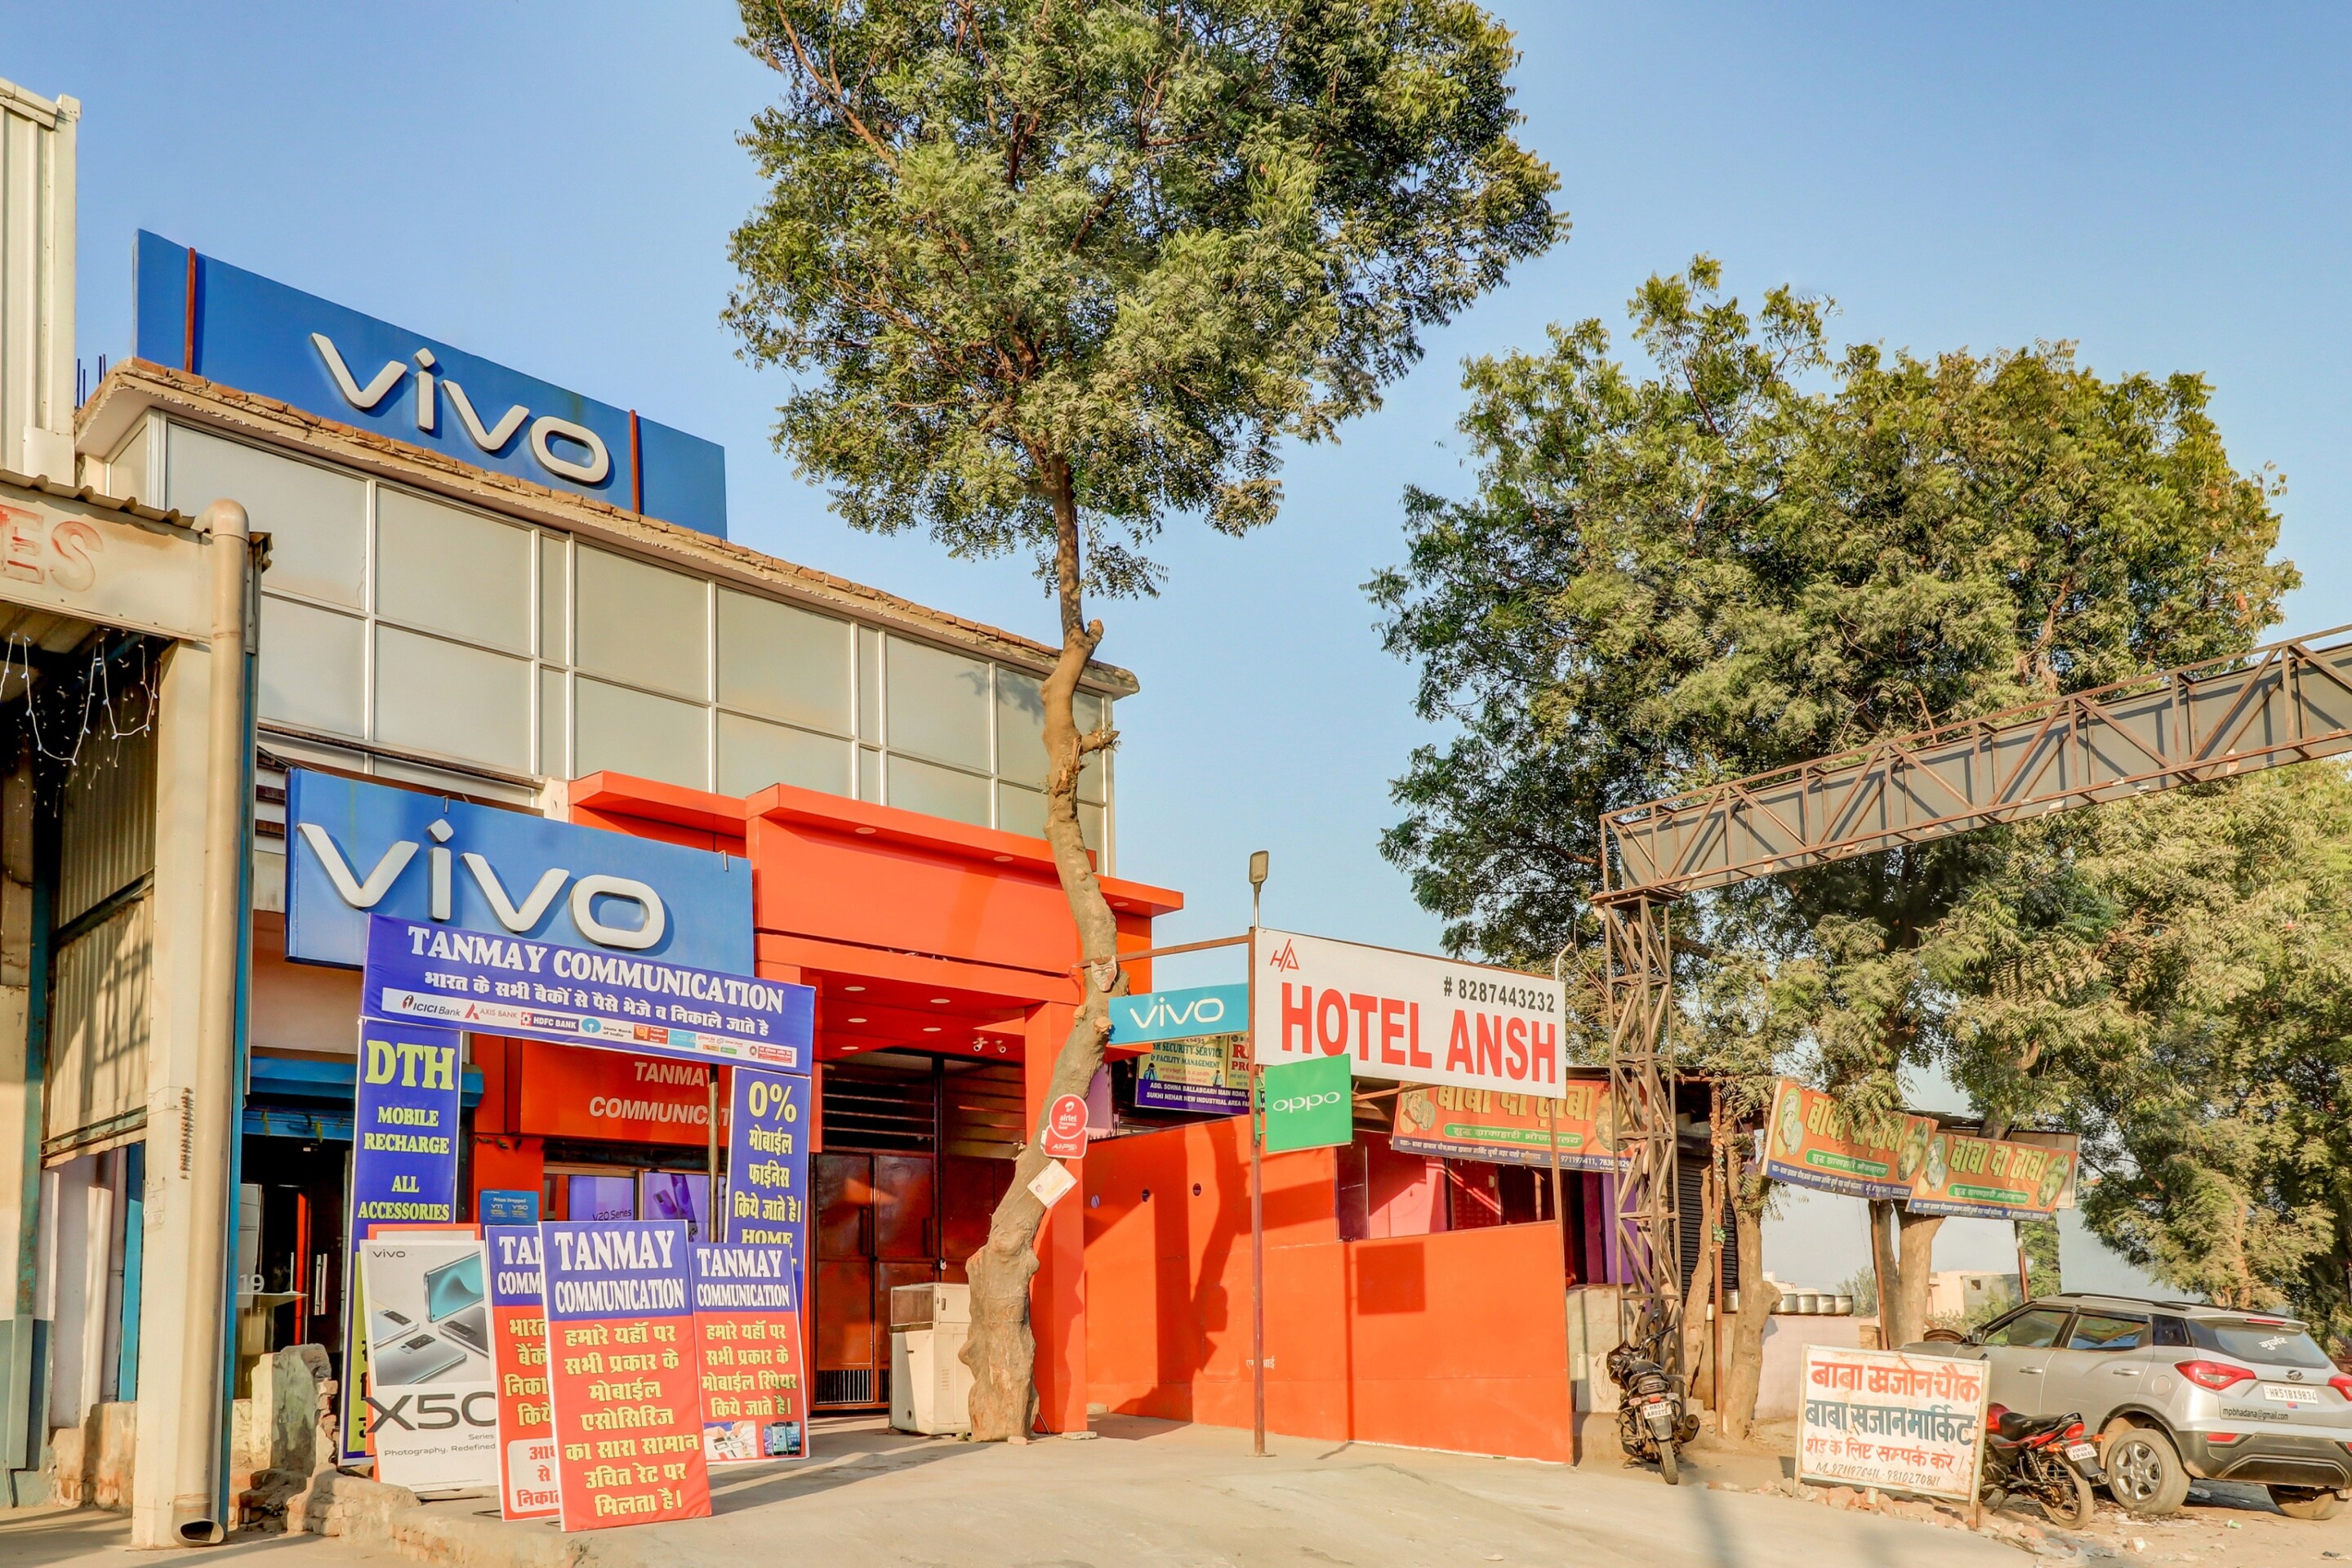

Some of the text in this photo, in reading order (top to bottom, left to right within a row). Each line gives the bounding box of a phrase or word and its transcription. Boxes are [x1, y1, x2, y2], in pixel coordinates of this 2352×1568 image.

[310, 332, 610, 484] vivo
[297, 817, 666, 950] vivo
[408, 925, 784, 1014] TANMAY COMMUNICATION
[413, 1002, 461, 1017] ICICI Bank
[425, 971, 469, 991] भारत
[473, 975, 490, 994] के
[495, 981, 530, 1000] सभी
[573, 989, 589, 1008] से
[670, 1004, 723, 1029] निकाले
[726, 1015, 755, 1035] जाते
[480, 1009, 518, 1018] AXIS BANK
[1129, 996, 1224, 1029] vivo
[532, 1016, 577, 1029] HDFC BANK
[1281, 982, 1556, 1084] HOTEL ANSH
[1156, 1054, 1180, 1064] FACILITY
[1181, 1058, 1220, 1068] MANAGEMENT
[1162, 1042, 1194, 1054] SECURITY
[1196, 1046, 1223, 1058] SERVICE
[364, 1039, 456, 1090] DTH
[748, 1080, 797, 1123] 0%
[1147, 1091, 1164, 1099] SUKHI
[1165, 1094, 1183, 1102] NEHAR
[1183, 1095, 1196, 1103] NEW
[1196, 1097, 1227, 1106] INDUSTRIAL
[1227, 1098, 1241, 1107] AREA
[1164, 1084, 1182, 1092] SOHNA
[1183, 1085, 1217, 1095] BALLABGARH
[1218, 1088, 1232, 1096] MAIN
[589, 1096, 730, 1127] COMMUNICT
[1272, 1091, 1341, 1114] oppo
[377, 1107, 439, 1127] MOBILE
[363, 1133, 450, 1154] RECHARGE
[748, 1124, 793, 1156] मोबाईल
[1949, 1138, 1991, 1175] बाबा
[1990, 1144, 2012, 1177] दा
[391, 1175, 420, 1193] ALL
[357, 1201, 450, 1222] ACCESSORIES
[610, 1209, 632, 1219] Series
[733, 1190, 760, 1219] किये
[762, 1195, 786, 1222] जाते
[741, 1228, 793, 1248] HOME
[372, 1249, 406, 1258] vivo
[554, 1230, 675, 1271] TANMAY
[697, 1248, 783, 1278] TANMAY
[555, 1278, 685, 1313] COMMUNICATION
[697, 1284, 791, 1307] COMMUNICATION
[564, 1324, 609, 1347] हमारे
[653, 1325, 676, 1343] पर
[706, 1321, 737, 1340] हमारे
[769, 1324, 786, 1339] पर
[564, 1348, 679, 1375] सभी प्रकार के
[706, 1344, 789, 1367] सभी प्रकार के
[702, 1370, 797, 1392] मोबाईल रिपेयर
[1811, 1360, 1864, 1392] बाबा
[588, 1376, 662, 1402] मोबाईल
[710, 1396, 742, 1418] किये
[744, 1396, 773, 1416] जाते
[1805, 1399, 1848, 1431] बाबा
[2223, 1407, 2288, 1421] mpbhadana@gmail.com
[384, 1443, 496, 1456] Photography. Redefined
[564, 1433, 700, 1461] का सारा सामान
[1829, 1435, 1843, 1455] के
[537, 1464, 550, 1482] से
[583, 1462, 687, 1489] उचित रेट पर
[594, 1493, 657, 1517] मिलता
